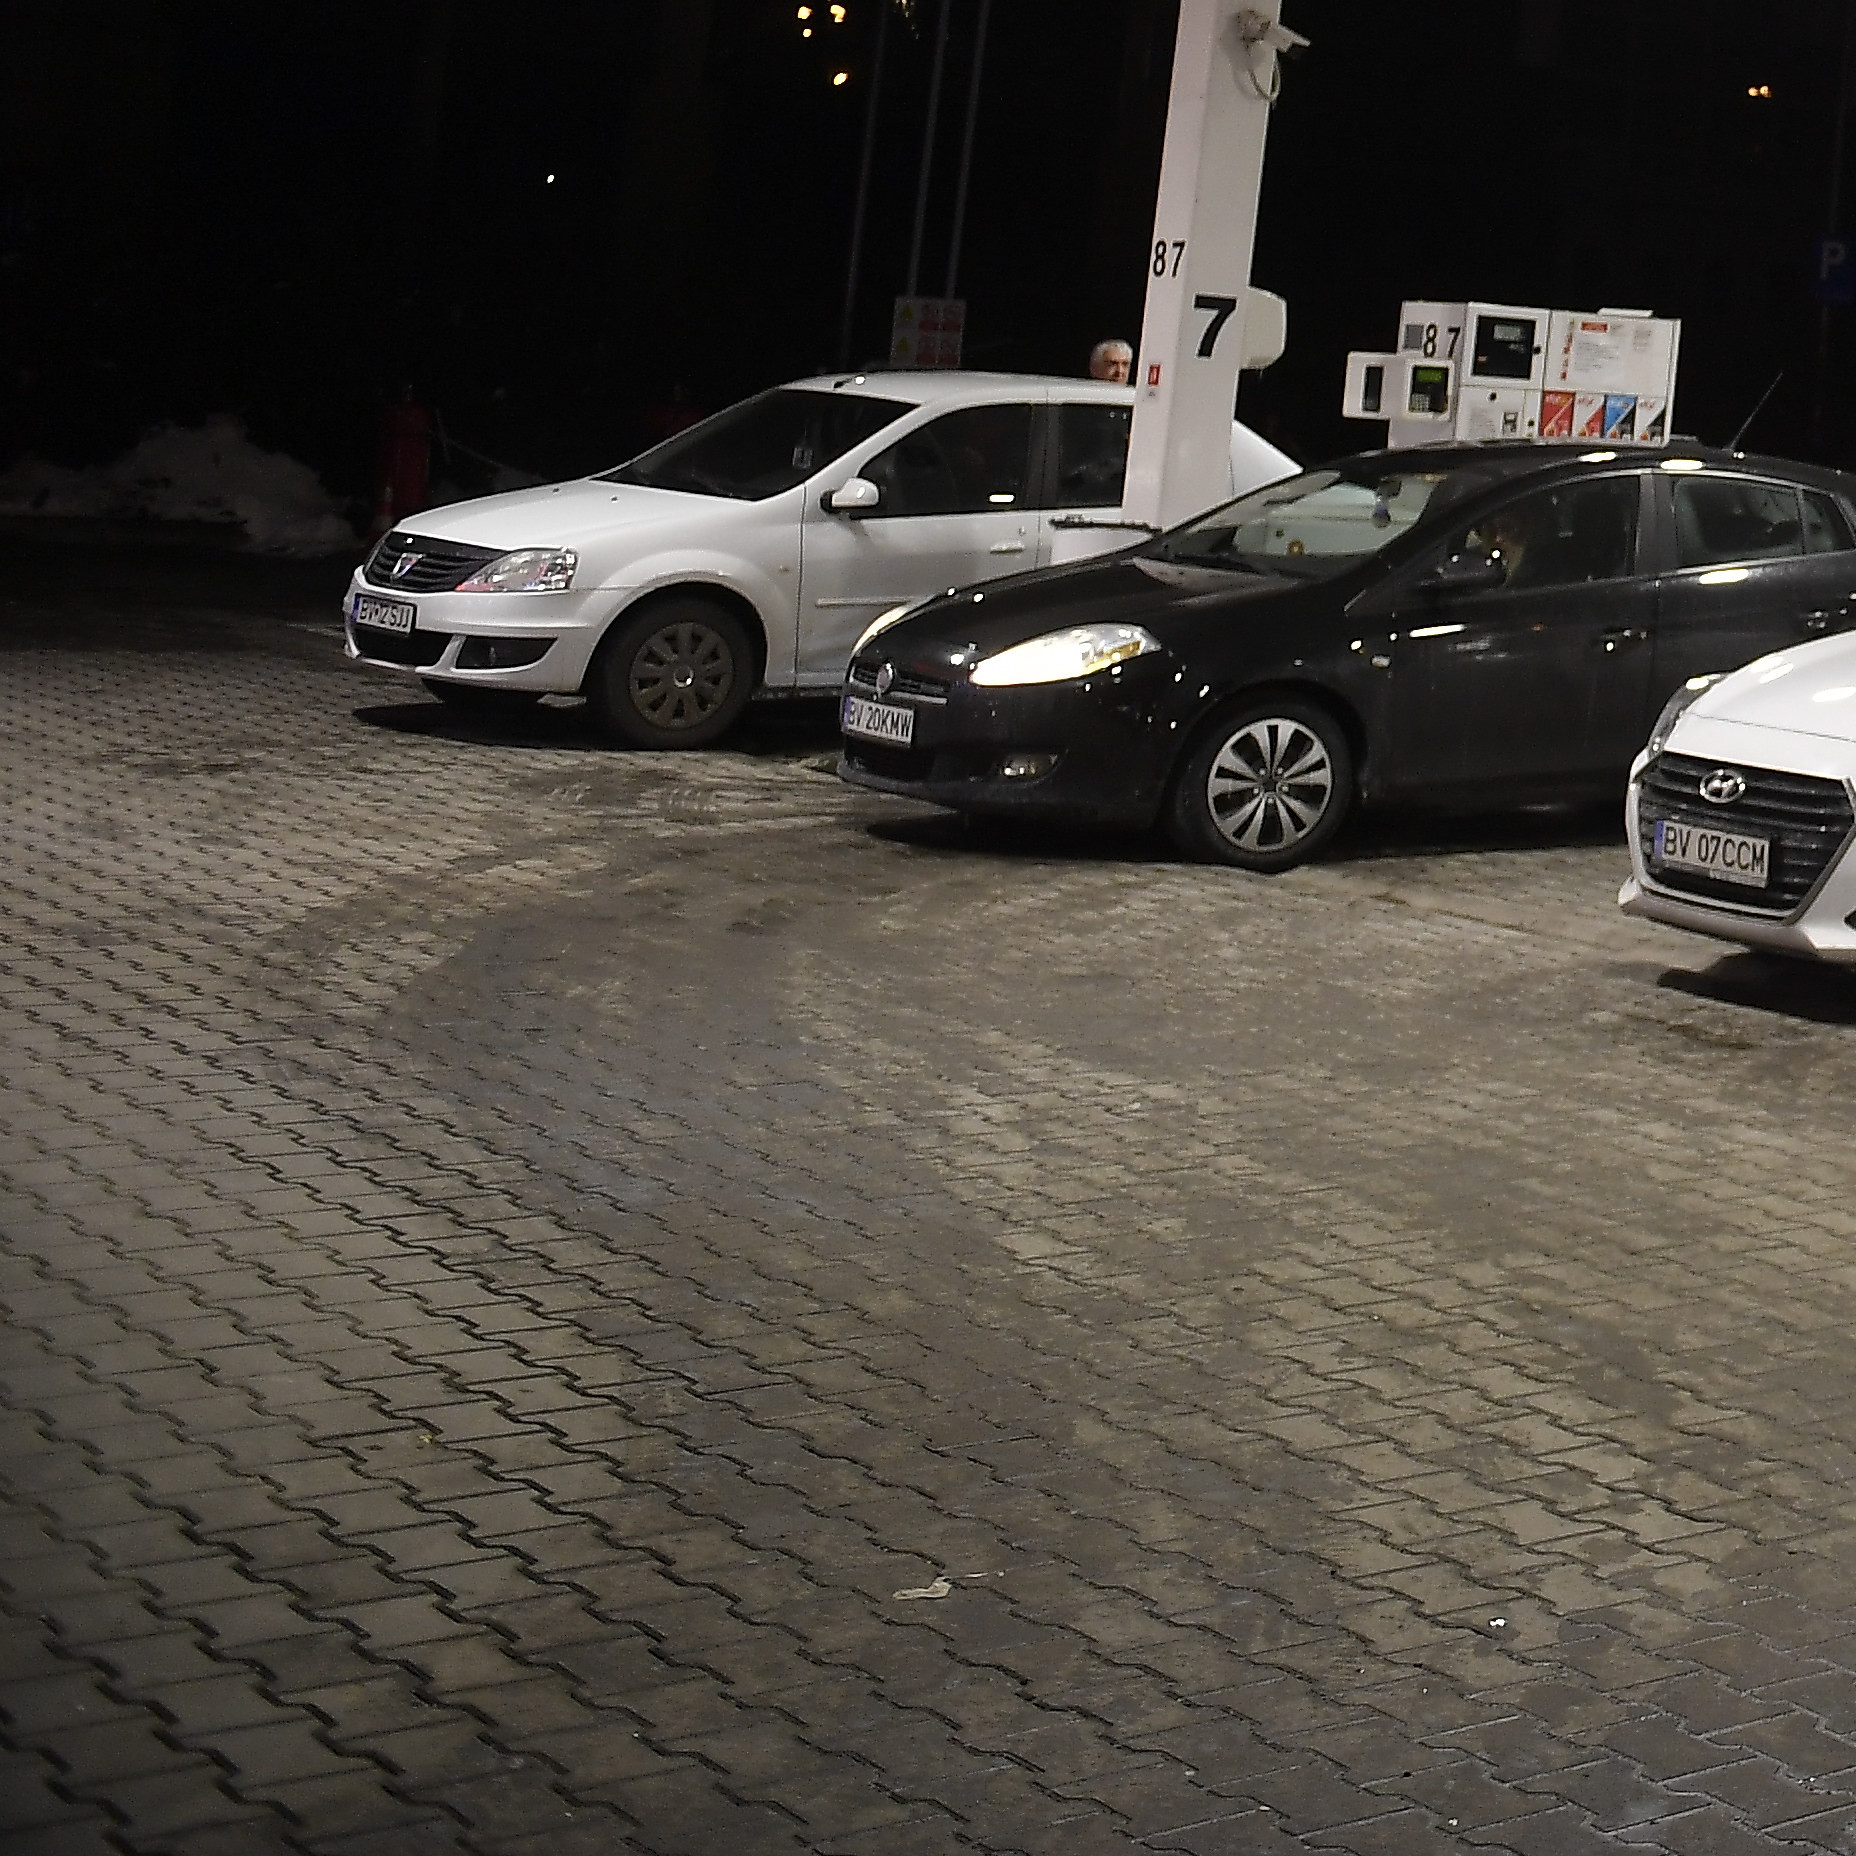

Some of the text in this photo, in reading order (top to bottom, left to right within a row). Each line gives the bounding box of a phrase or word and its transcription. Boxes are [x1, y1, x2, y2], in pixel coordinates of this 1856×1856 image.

[1193, 294, 1237, 357] 7
[1664, 826, 1765, 873] BV 07CCM
